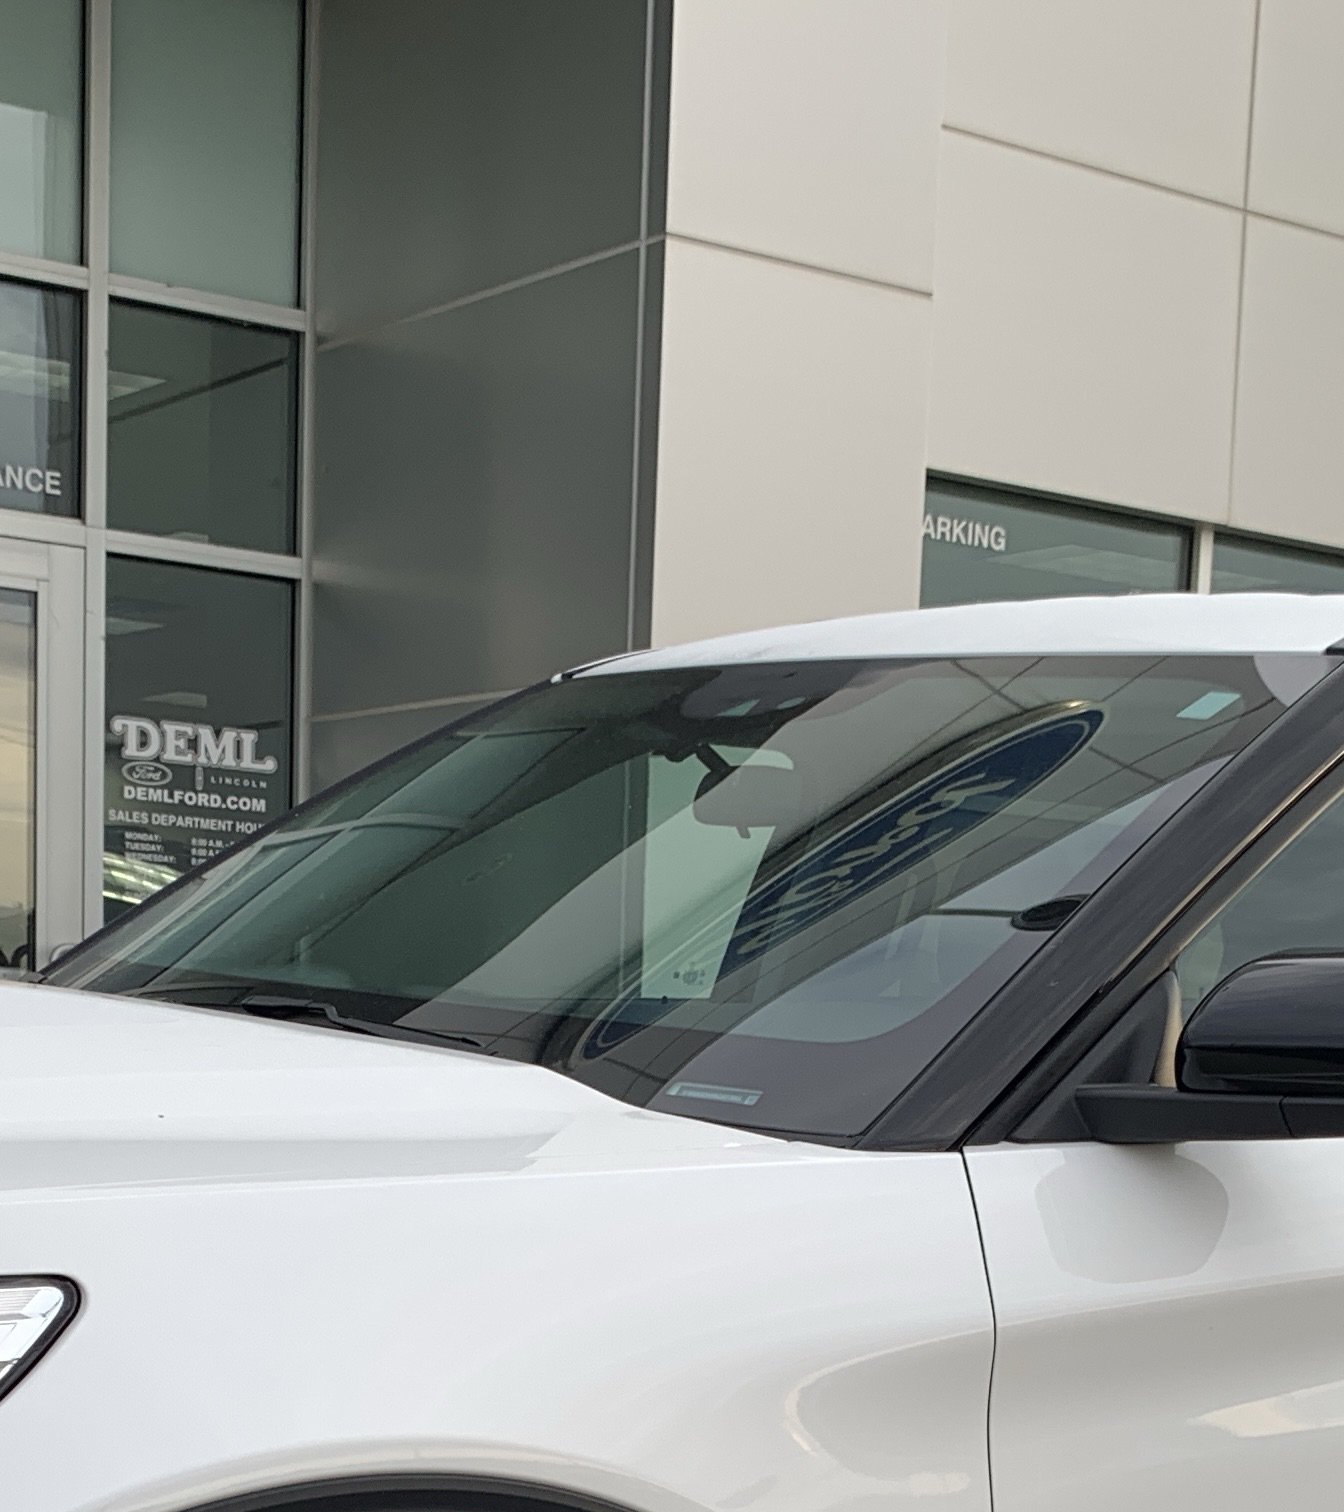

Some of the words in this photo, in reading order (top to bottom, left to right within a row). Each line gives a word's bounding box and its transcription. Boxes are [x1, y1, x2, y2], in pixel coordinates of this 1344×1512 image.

[111, 716, 278, 774] DEML
[211, 776, 267, 789] LINCOLN
[123, 786, 267, 813] DEMLFORD.COM
[109, 809, 149, 824] SALES
[152, 813, 234, 832] DEPARTMENT
[236, 821, 265, 834] HOU
